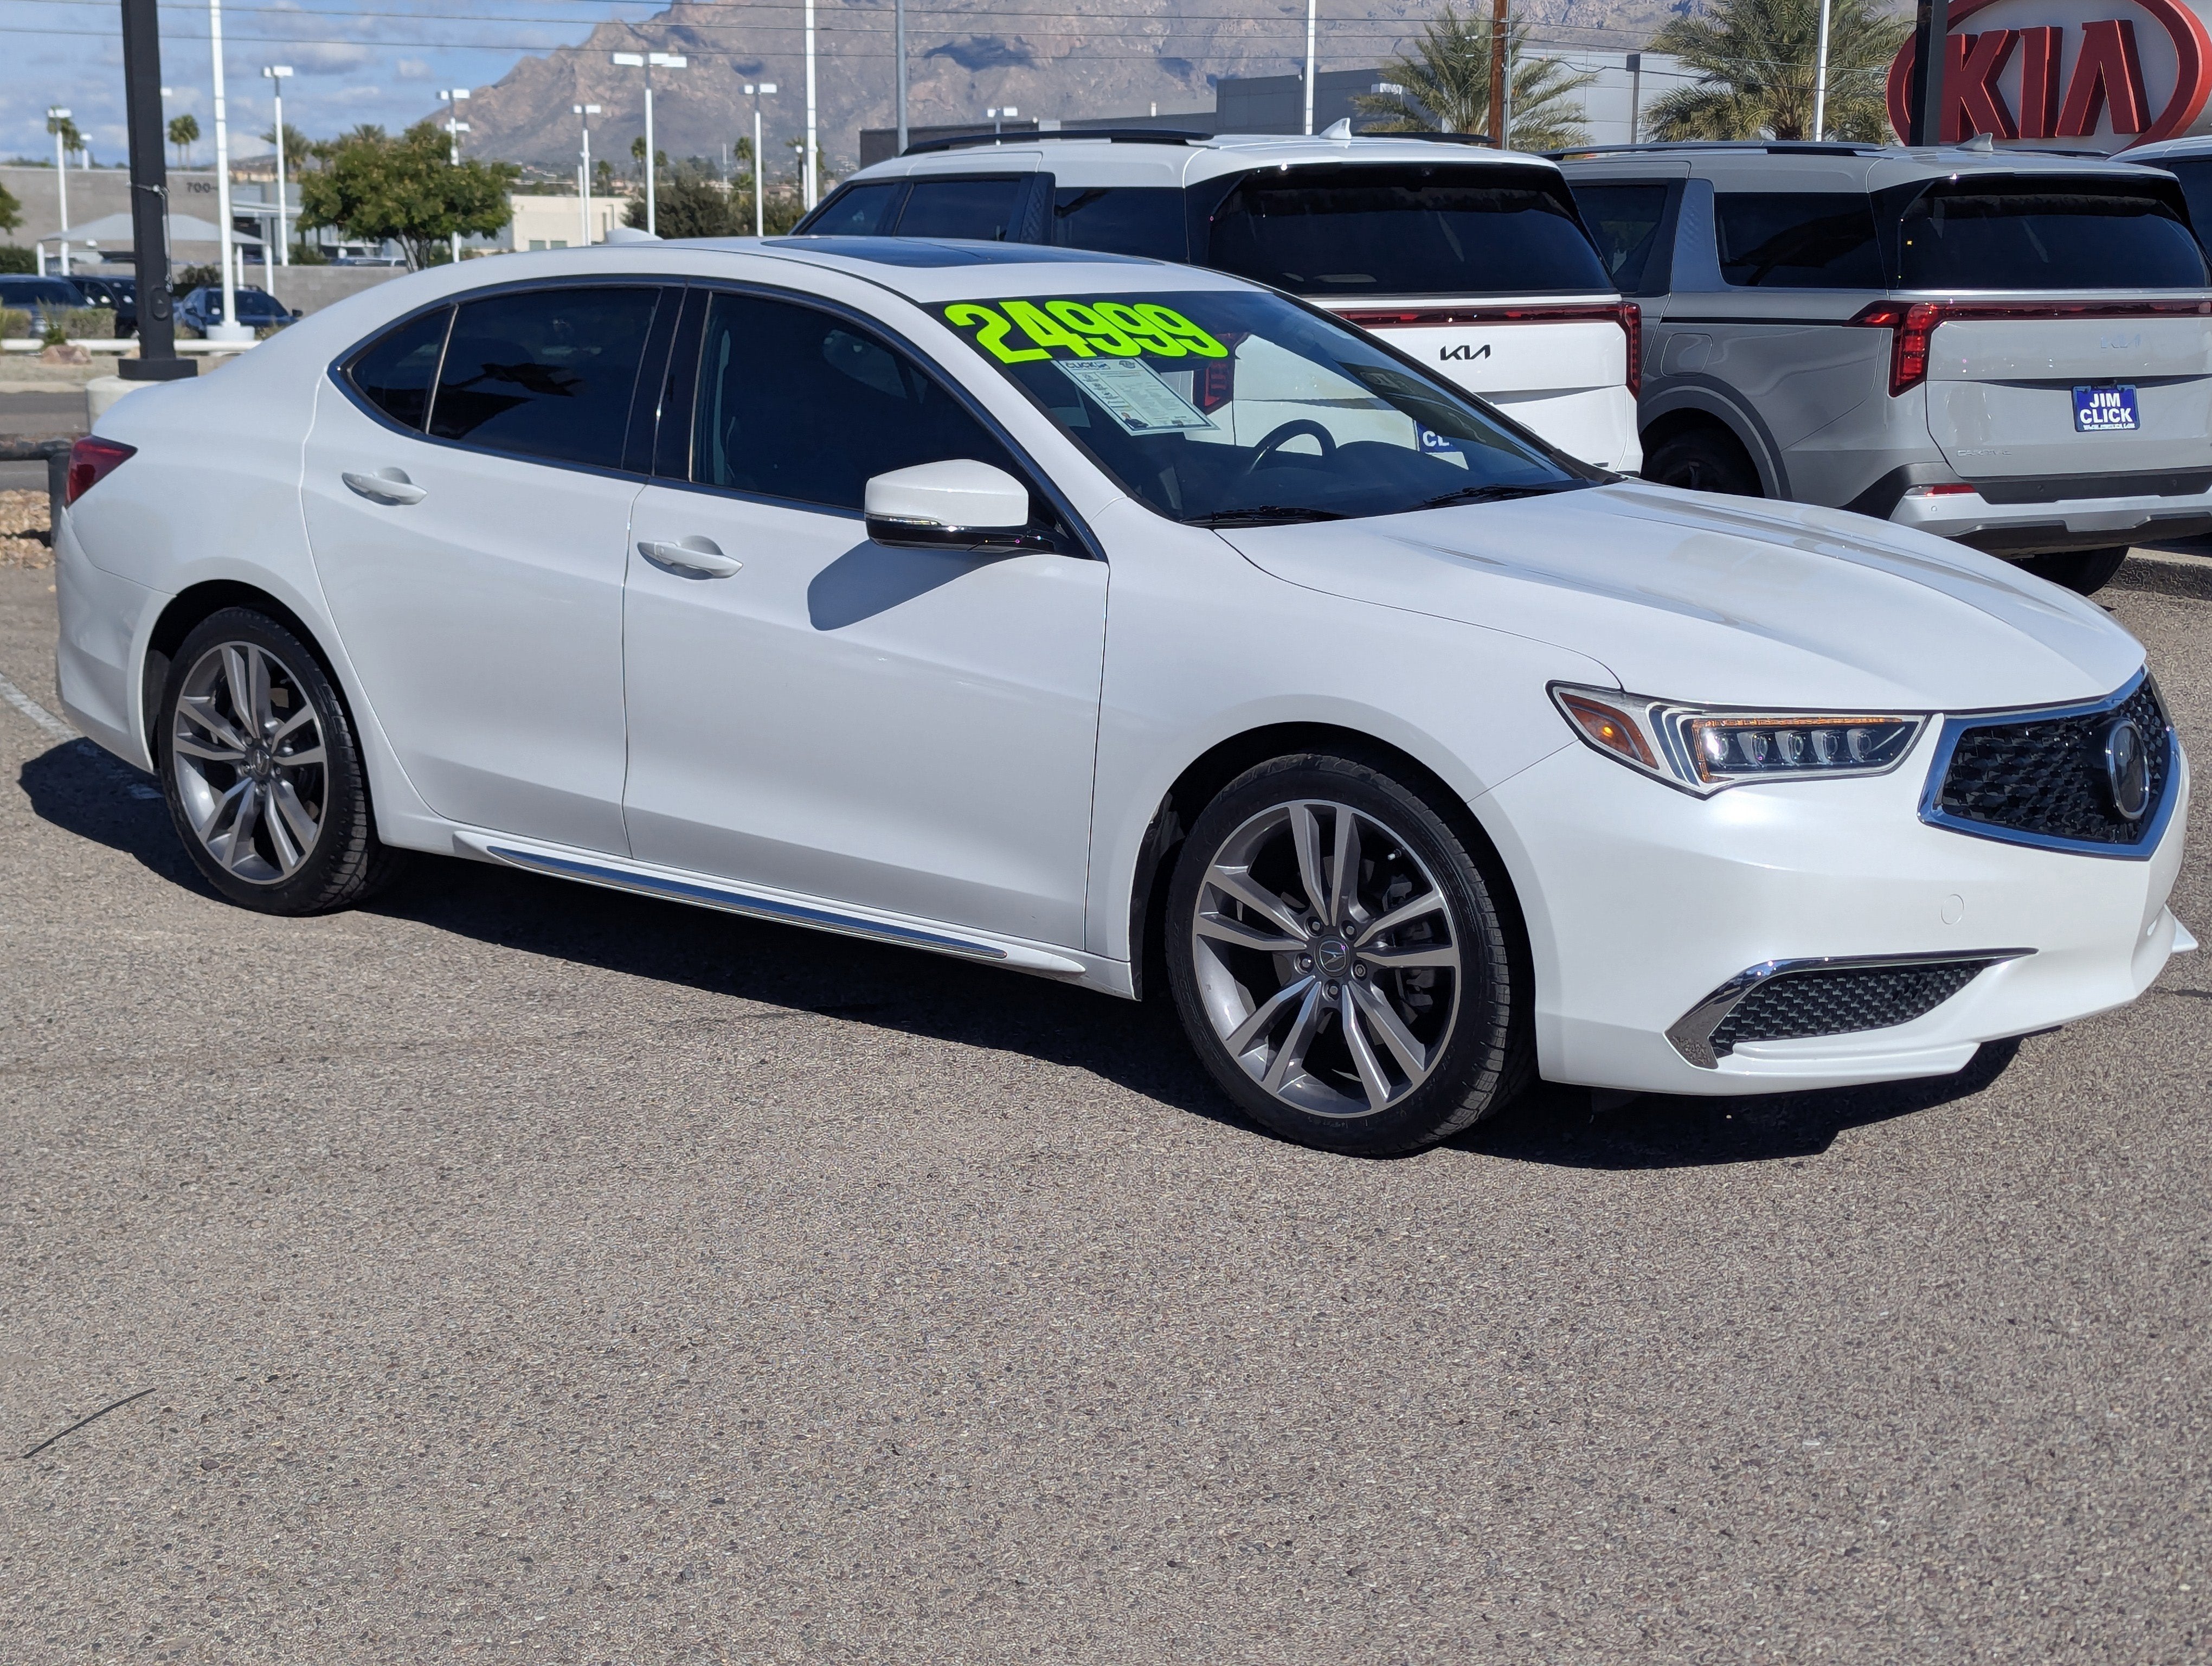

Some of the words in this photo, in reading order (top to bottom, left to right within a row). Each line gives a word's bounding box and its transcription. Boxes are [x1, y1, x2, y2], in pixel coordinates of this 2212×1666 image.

[1939, 20, 2152, 142] KIA
[945, 301, 1228, 363] 24999
[1440, 344, 1490, 361] KIA
[2089, 393, 2120, 408] JIM
[2080, 408, 2133, 424] CLICK
